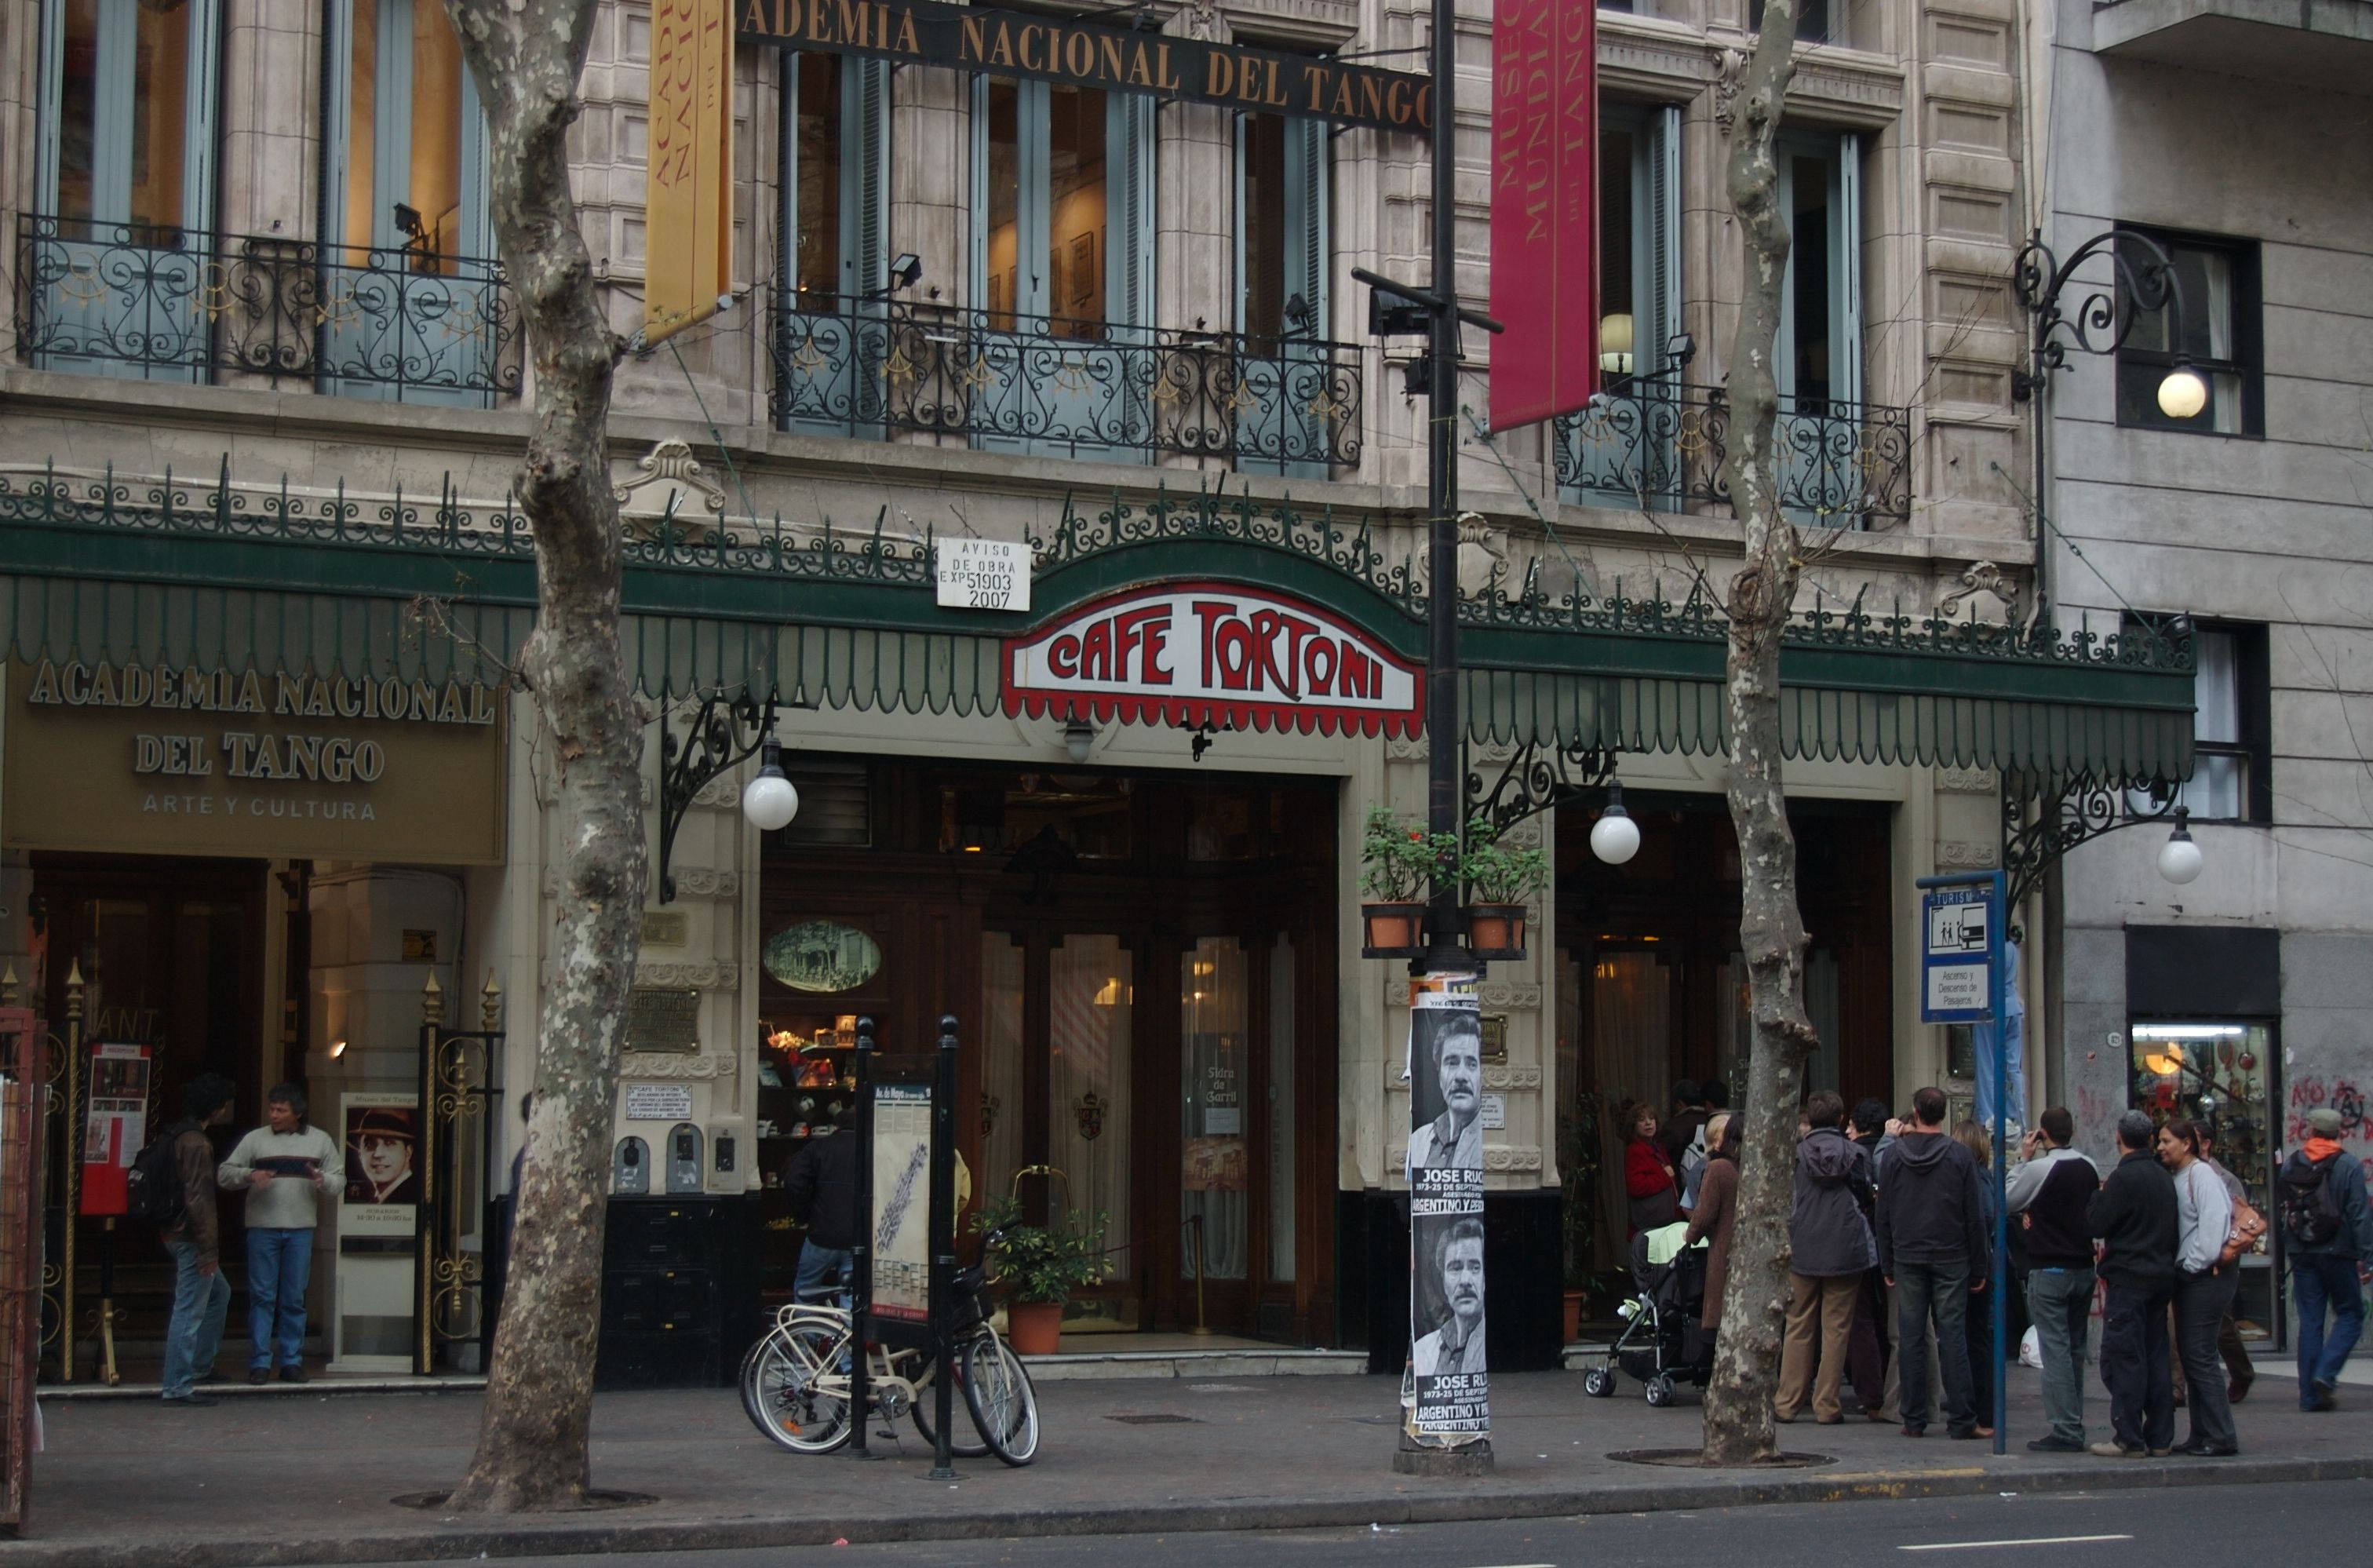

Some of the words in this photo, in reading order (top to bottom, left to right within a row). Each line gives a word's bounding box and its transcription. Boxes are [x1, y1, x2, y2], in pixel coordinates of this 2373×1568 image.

[959, 13, 1179, 90] NACIONAL
[1205, 51, 1288, 107] DEL
[1569, 176, 1580, 222] DEL
[962, 542, 1009, 556] AVISO
[953, 560, 970, 571] DE
[979, 560, 1015, 573] OBRA
[967, 573, 1011, 590] 51903
[970, 590, 1010, 608] 2007
[1047, 603, 1174, 685] CAFE
[1192, 601, 1383, 702] TORTONI
[29, 660, 266, 713] ACADEMIA
[275, 671, 497, 725] NACIONAL
[134, 735, 213, 776] DEL
[223, 732, 386, 782] TANGO
[142, 794, 213, 815] ARTE
[225, 796, 238, 815] Y
[250, 798, 377, 821] CULTURA
[1942, 971, 1967, 981] Ascenso
[1969, 972, 1974, 982] y
[1938, 983, 1968, 994] Descenso
[1969, 983, 1978, 993] de
[1943, 996, 1972, 1008] Pasajeros
[1208, 1067, 1234, 1079] Sidra
[1213, 1079, 1225, 1090] de
[1423, 1169, 1460, 1183] JOSE
[1463, 1199, 1470, 1212] Y
[1434, 1375, 1469, 1390] JOSE
[1423, 1389, 1453, 1398] 1973-25
[1417, 1403, 1473, 1420] ARGENTINO
[1474, 1403, 1481, 1417] Y
